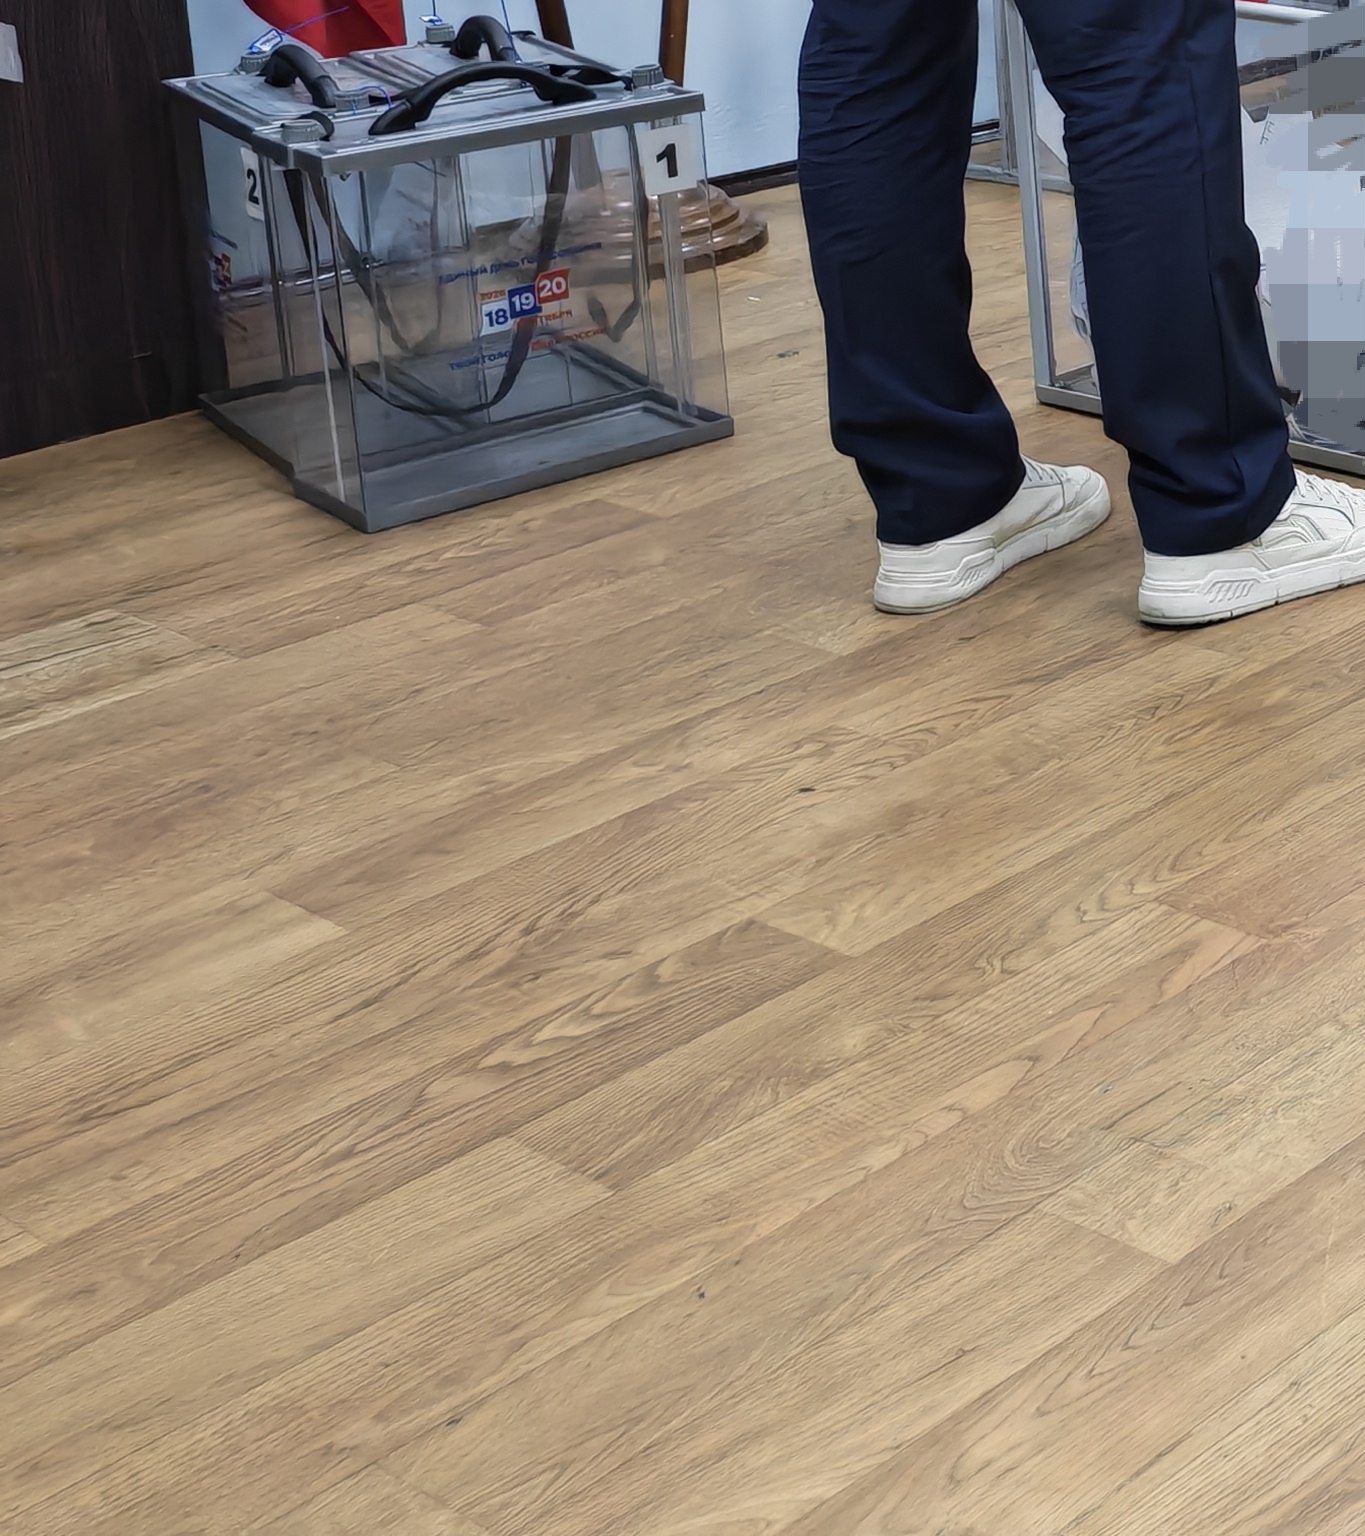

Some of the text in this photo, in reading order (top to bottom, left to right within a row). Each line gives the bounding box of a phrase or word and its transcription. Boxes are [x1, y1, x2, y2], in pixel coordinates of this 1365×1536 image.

[656, 143, 678, 178] 1
[247, 168, 259, 205] 2
[539, 277, 566, 298] 20
[511, 293, 535, 312] 19
[485, 308, 508, 327] 18
